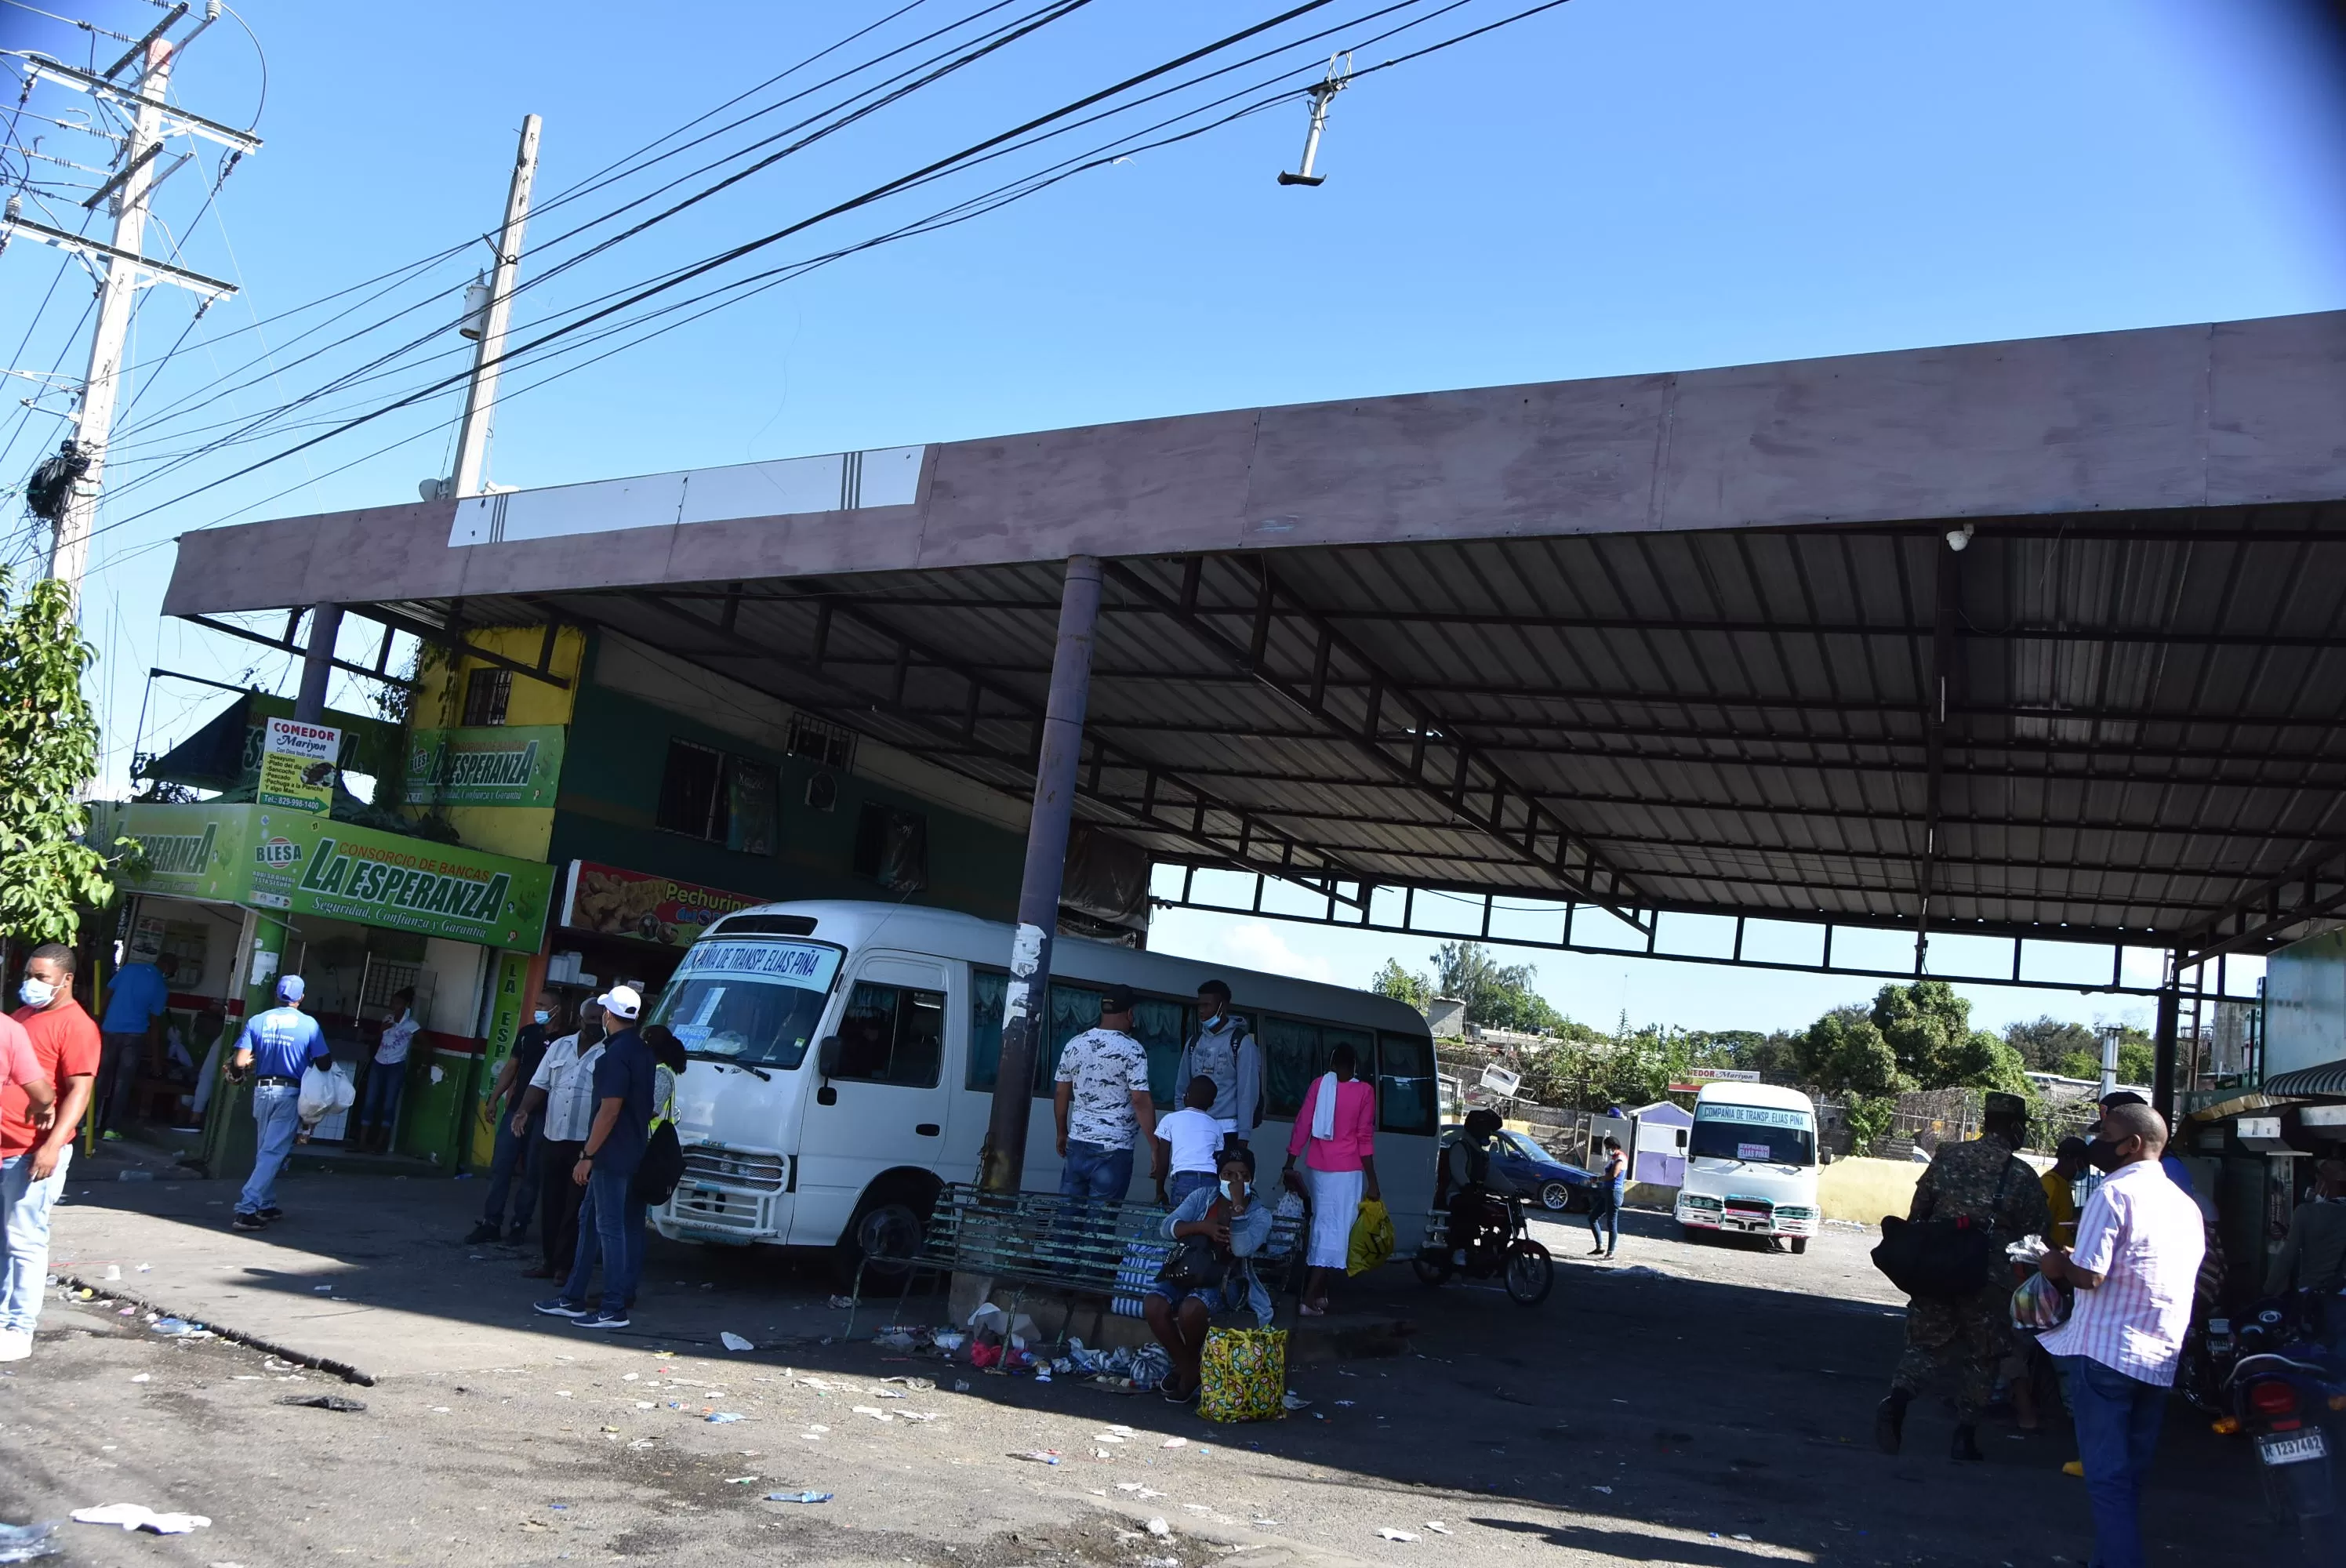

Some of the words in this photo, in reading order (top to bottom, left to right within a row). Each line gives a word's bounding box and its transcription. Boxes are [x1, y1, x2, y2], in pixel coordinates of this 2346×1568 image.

[274, 722, 336, 742] COMEDOR
[276, 735, 327, 753] Mariyon
[450, 739, 539, 786] ESPERANZA
[302, 784, 324, 793] Plancha
[278, 797, 319, 810] 829-998-1400
[256, 844, 303, 863] BLESA
[339, 841, 417, 868] CONSORCIO
[419, 857, 438, 871] DE
[438, 861, 490, 882] BANCAS
[298, 837, 351, 897] LA
[342, 858, 512, 924] ESPERANZA
[312, 896, 371, 920] Seguridad,
[376, 908, 430, 929] Confianza
[431, 920, 438, 932] y
[717, 948, 732, 969] DE
[728, 948, 765, 971] TRANSP.
[763, 949, 795, 973] ELIAS
[790, 949, 820, 977] PIÑA
[503, 963, 518, 995] LA
[675, 1026, 710, 1037] EXPRESO
[1716, 1070, 1755, 1081] Mariyon
[1704, 1106, 1735, 1120] COMPAÑIA
[1736, 1109, 1745, 1120] DE
[1745, 1110, 1770, 1123] TRANSP.
[1771, 1112, 1789, 1124] ELIAS
[1789, 1113, 1804, 1127] PIÑA
